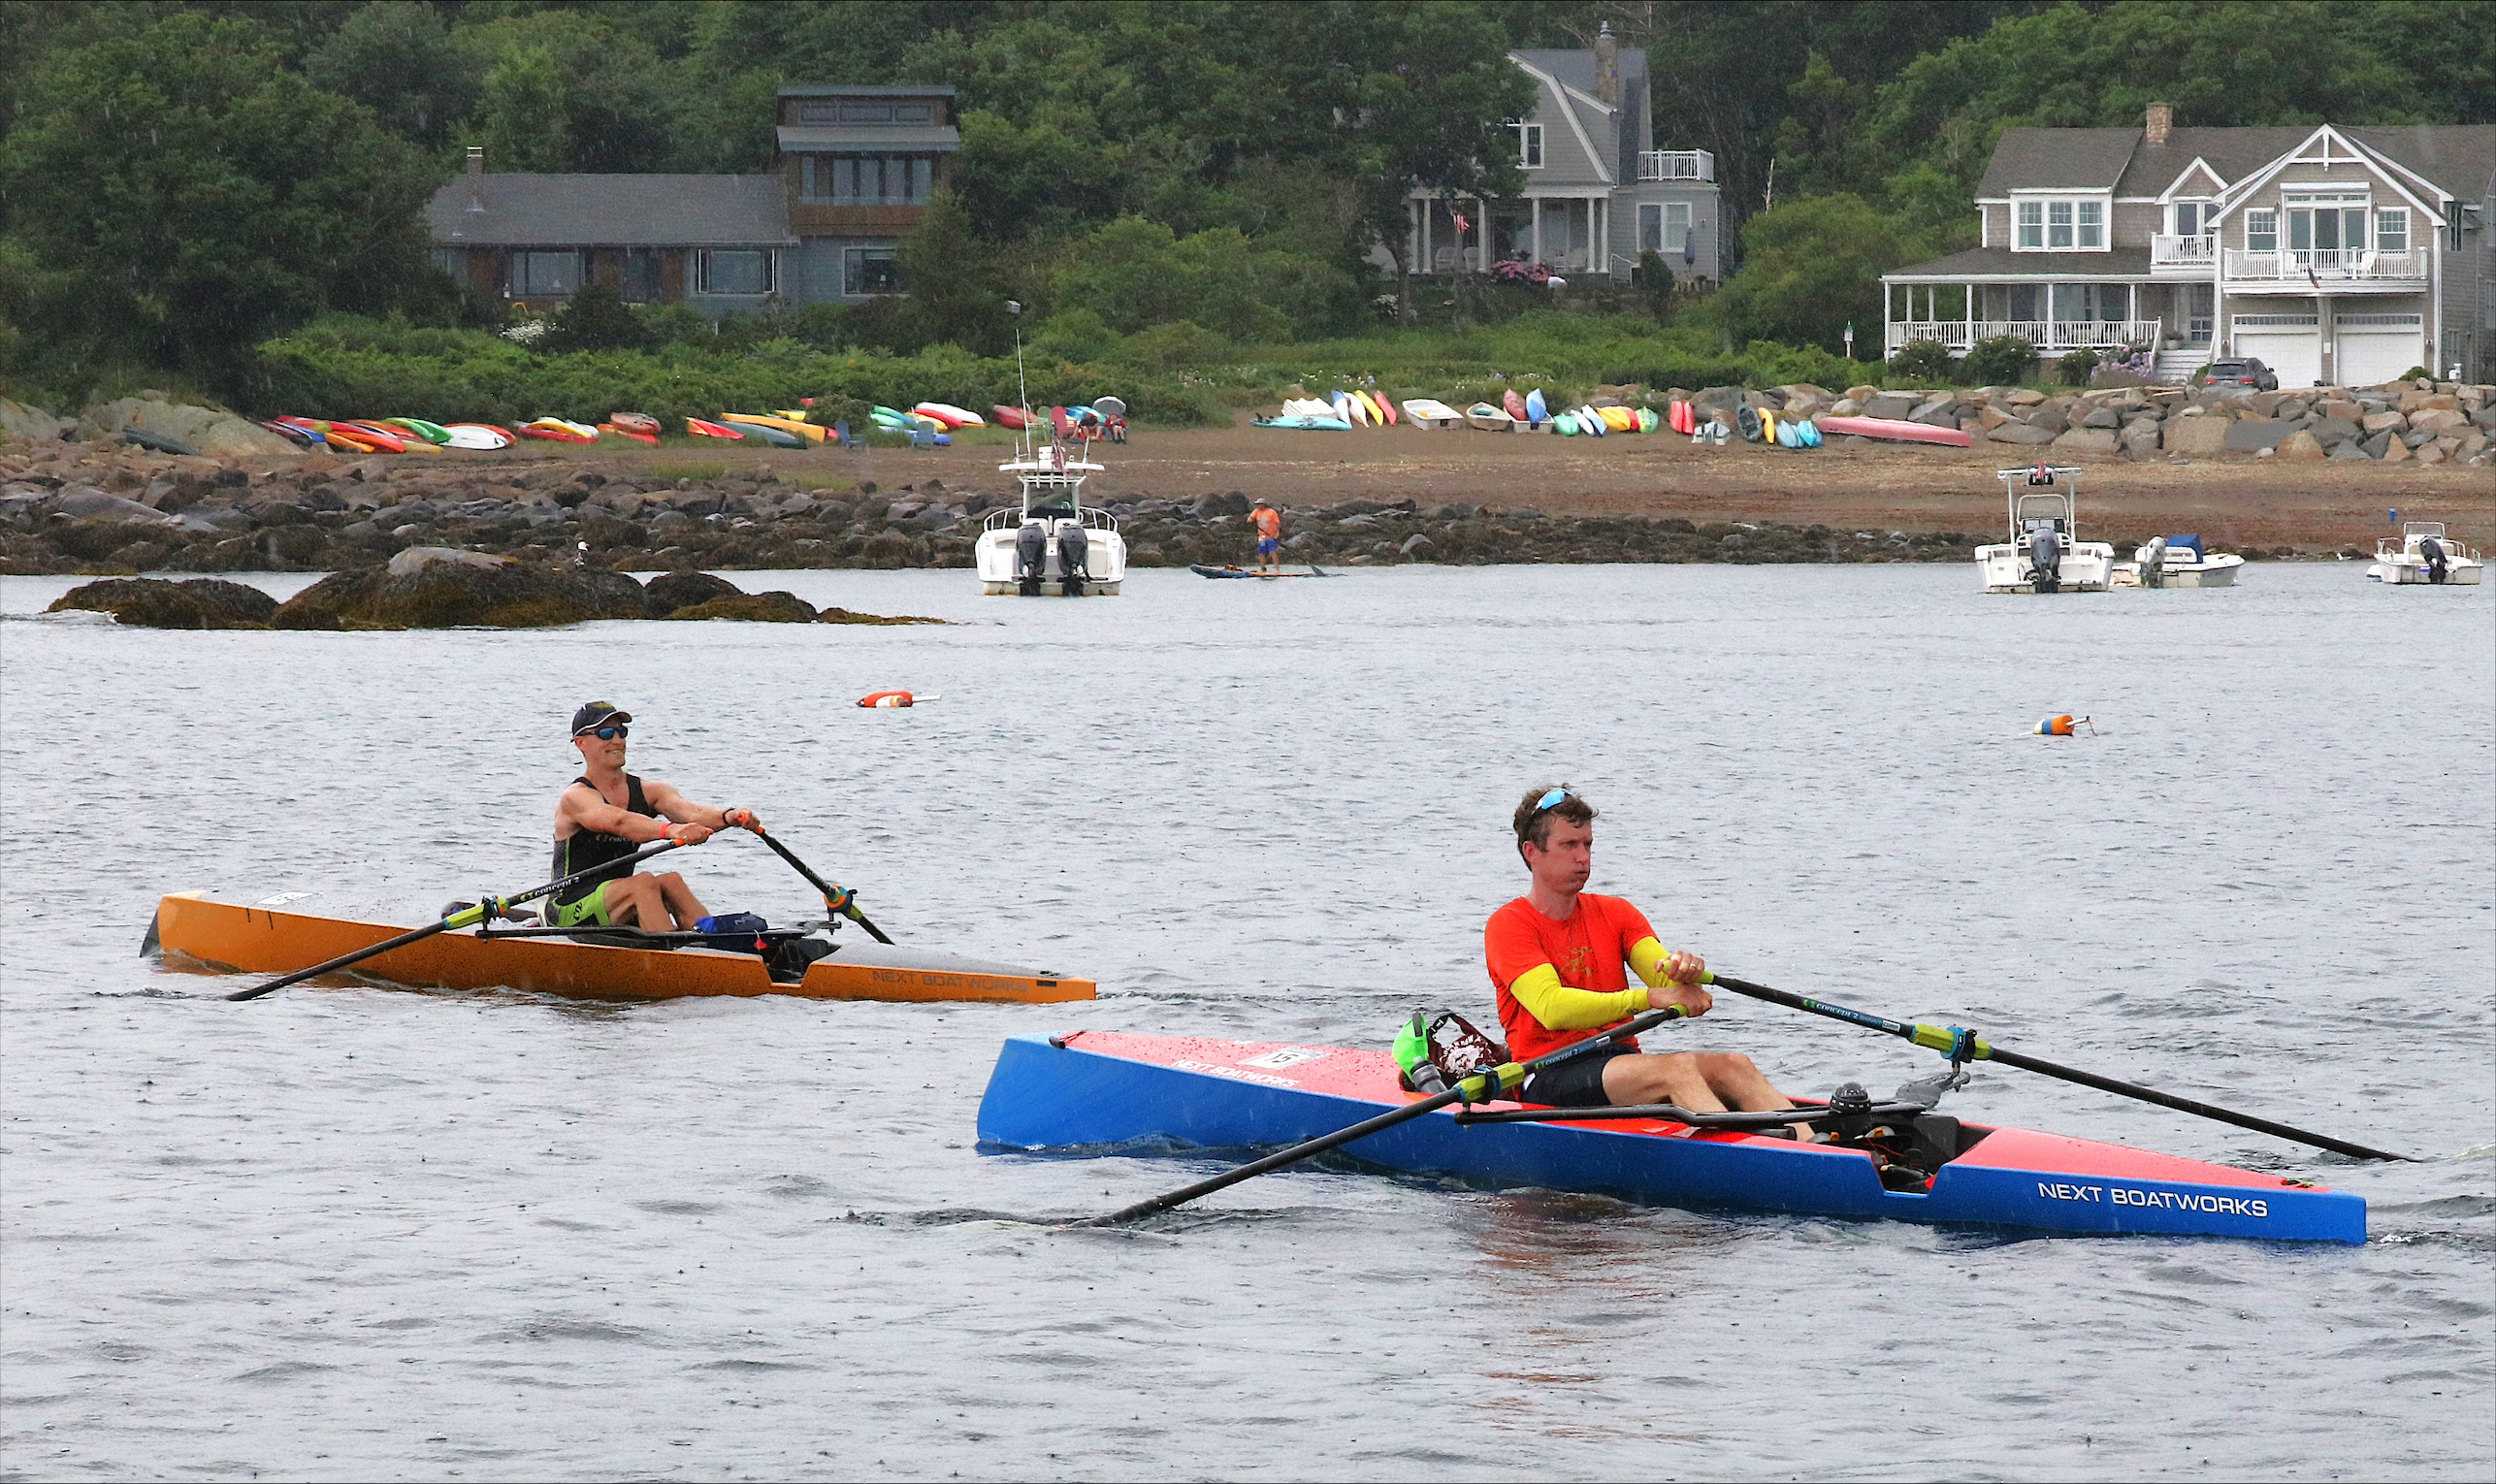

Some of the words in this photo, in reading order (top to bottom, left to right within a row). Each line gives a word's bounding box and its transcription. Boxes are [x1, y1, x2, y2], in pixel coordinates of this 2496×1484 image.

[873, 971, 916, 984] NEXT
[923, 975, 1028, 992] BOATWORKS
[1816, 1003, 1852, 1017] concept
[1853, 1012, 1860, 1020] 2
[1171, 1059, 1215, 1072] NEXT
[1209, 1067, 1300, 1087] BOATWORKS
[2037, 1182, 2102, 1203] NEXT
[2111, 1188, 2268, 1217] BOATWORKS
